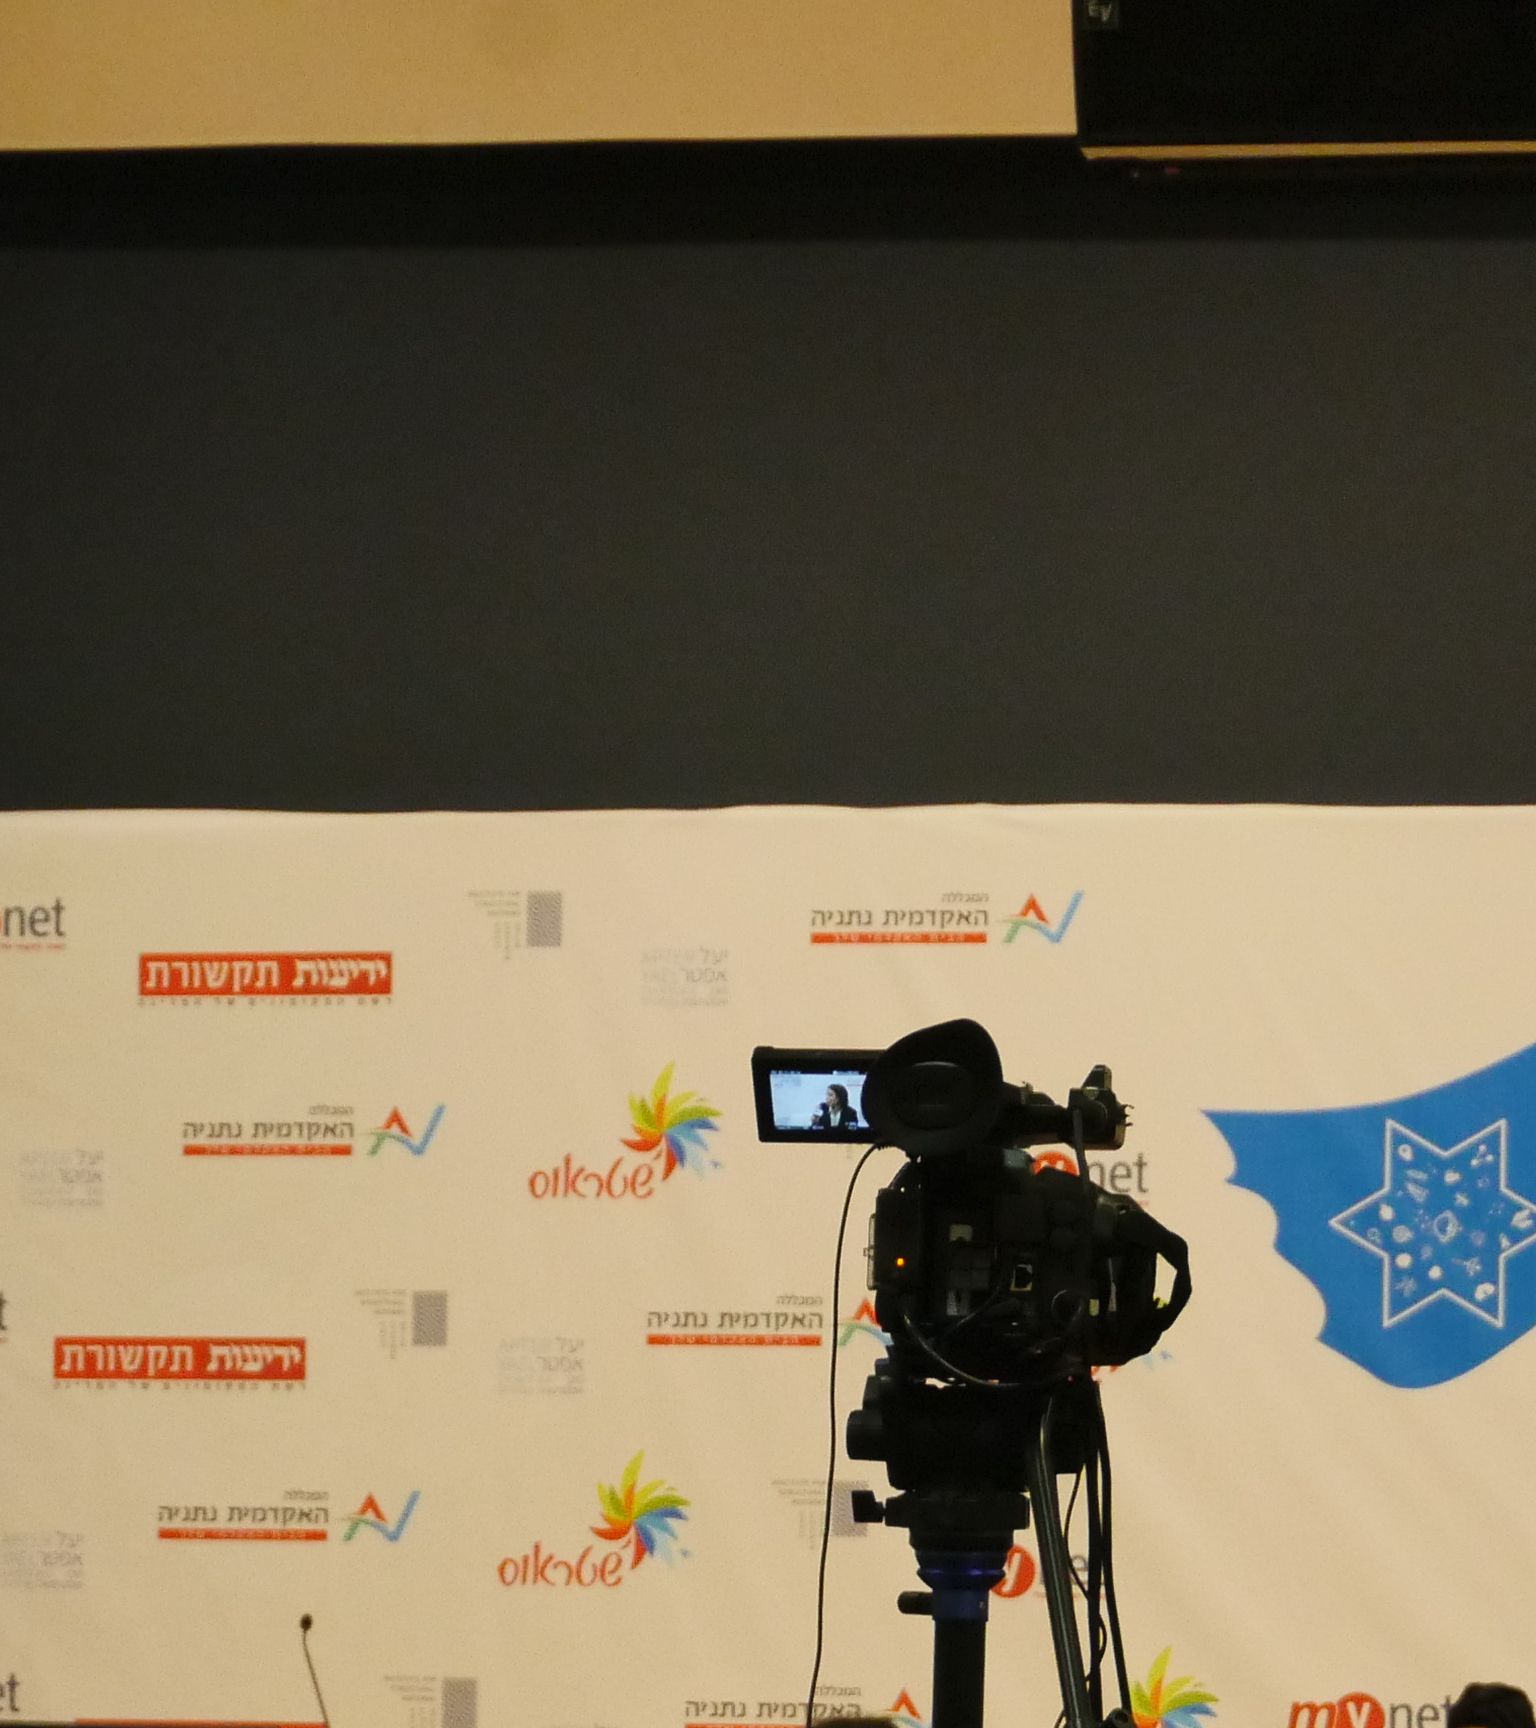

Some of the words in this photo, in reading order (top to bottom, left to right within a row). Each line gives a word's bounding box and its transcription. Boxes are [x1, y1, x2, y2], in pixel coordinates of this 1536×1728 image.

[811, 908, 873, 928] נתניה
[882, 908, 989, 929] האקדמית
[145, 960, 281, 993] תקשורת
[291, 958, 389, 988] ידיעות
[182, 1120, 243, 1139] נתניה
[252, 1120, 355, 1141] האקדמית
[528, 1153, 654, 1199] שטראוס
[647, 1310, 708, 1329] נתניה
[716, 1310, 824, 1332] האקדמית
[60, 1344, 194, 1377] תקשורת
[206, 1342, 303, 1373] ידיעות
[158, 1504, 218, 1523] נתניה
[226, 1505, 329, 1526] האקדמית
[497, 1541, 623, 1587] שטראוס
[684, 1700, 746, 1718] נתניה
